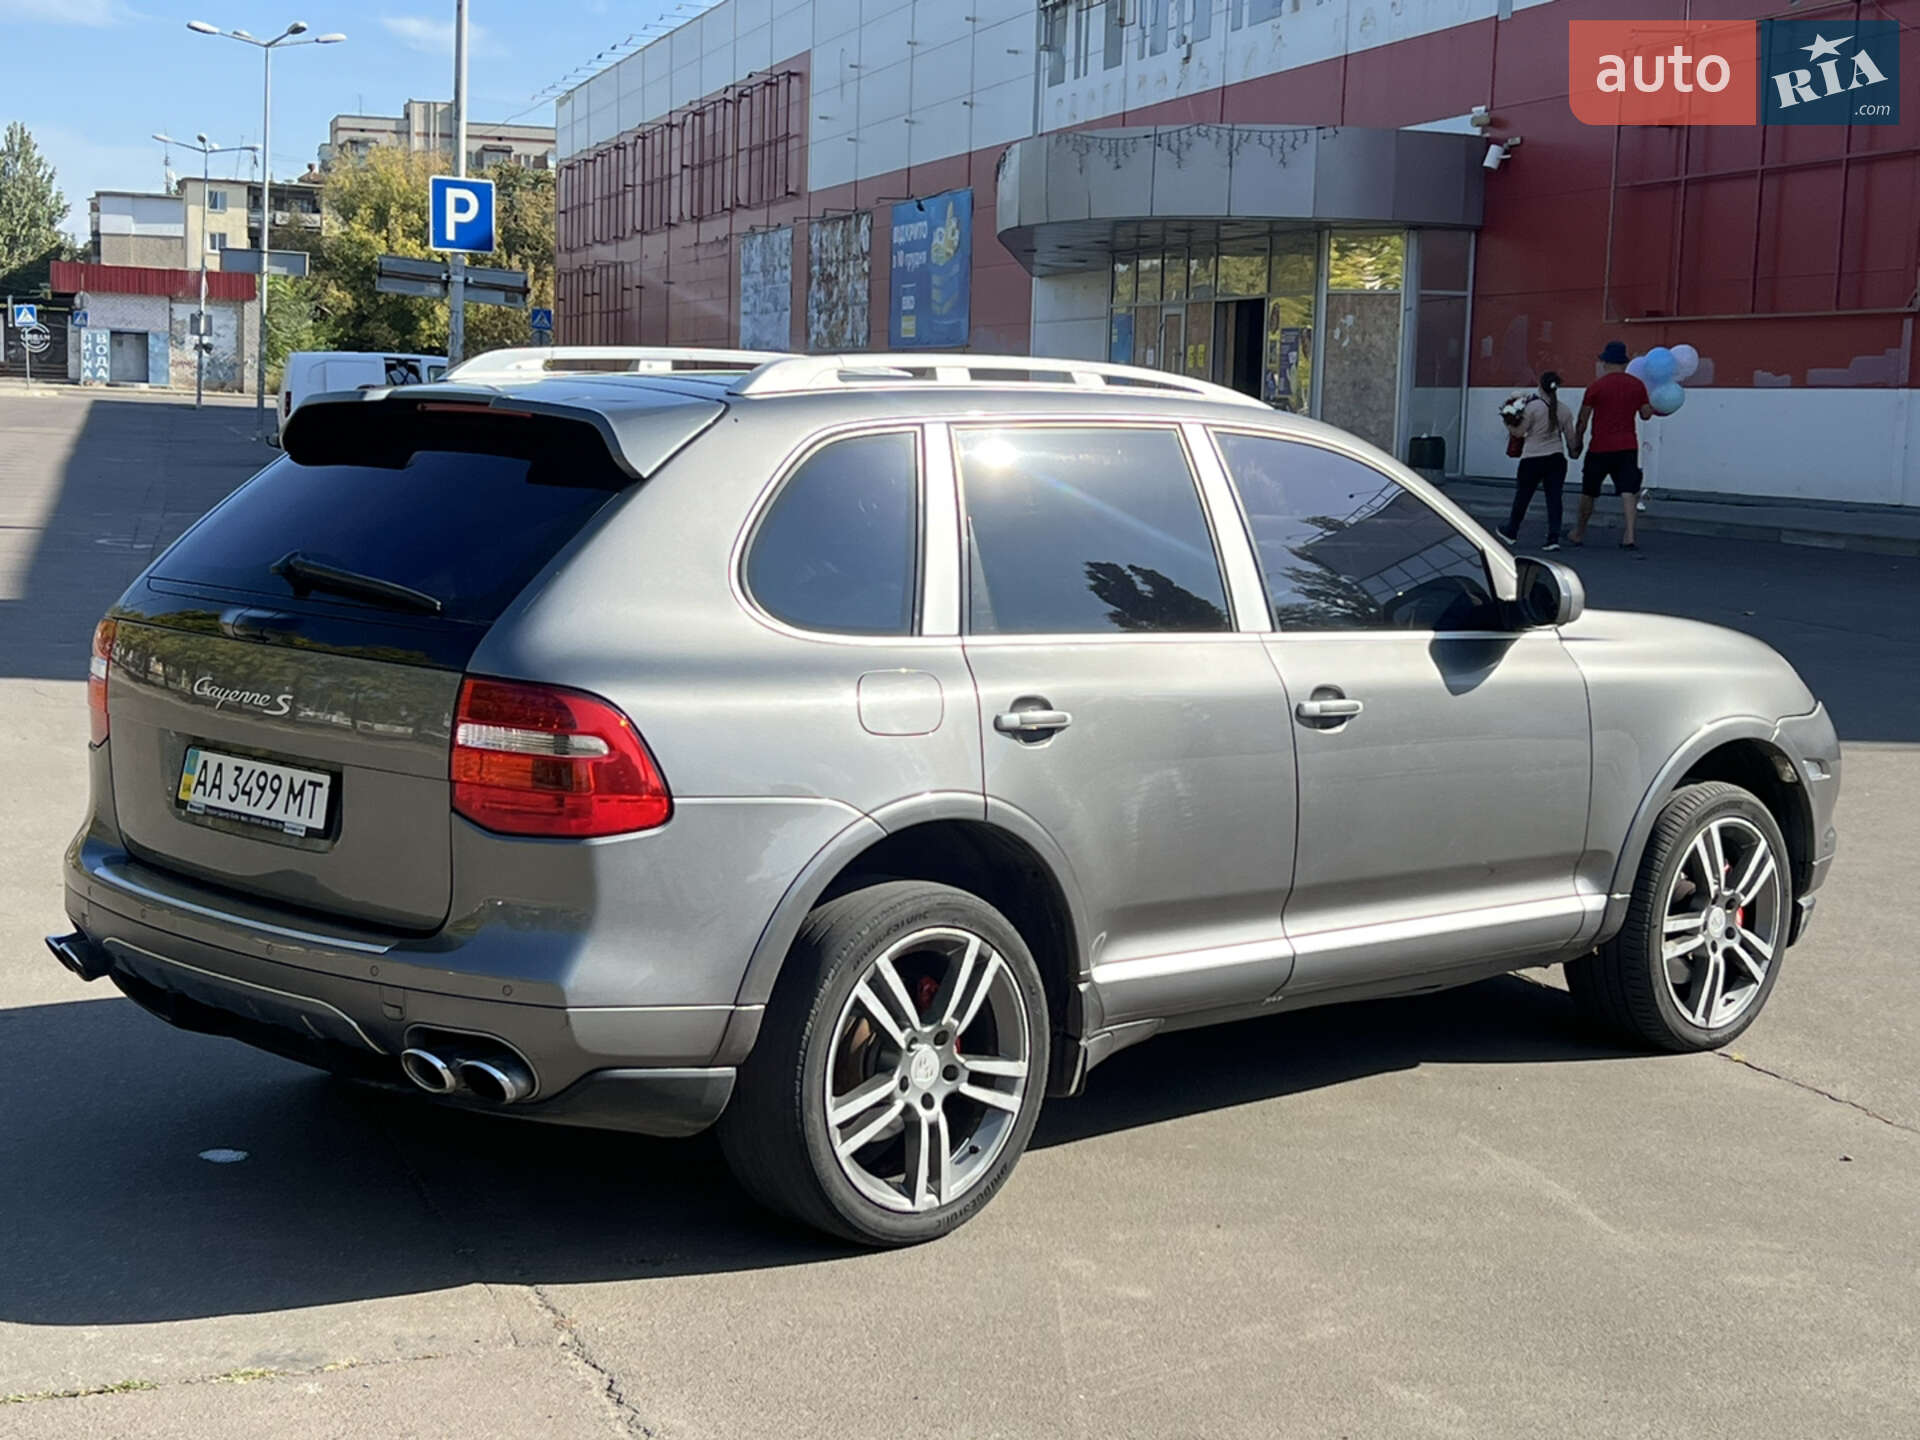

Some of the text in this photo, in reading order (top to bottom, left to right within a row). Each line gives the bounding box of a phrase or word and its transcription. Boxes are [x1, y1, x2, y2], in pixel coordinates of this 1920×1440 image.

[445, 186, 480, 241] P
[96, 333, 108, 378] ВОДА
[193, 676, 293, 716] Cayenne S
[193, 759, 223, 800] AA
[228, 765, 283, 811] 3499
[284, 776, 324, 820] MT
